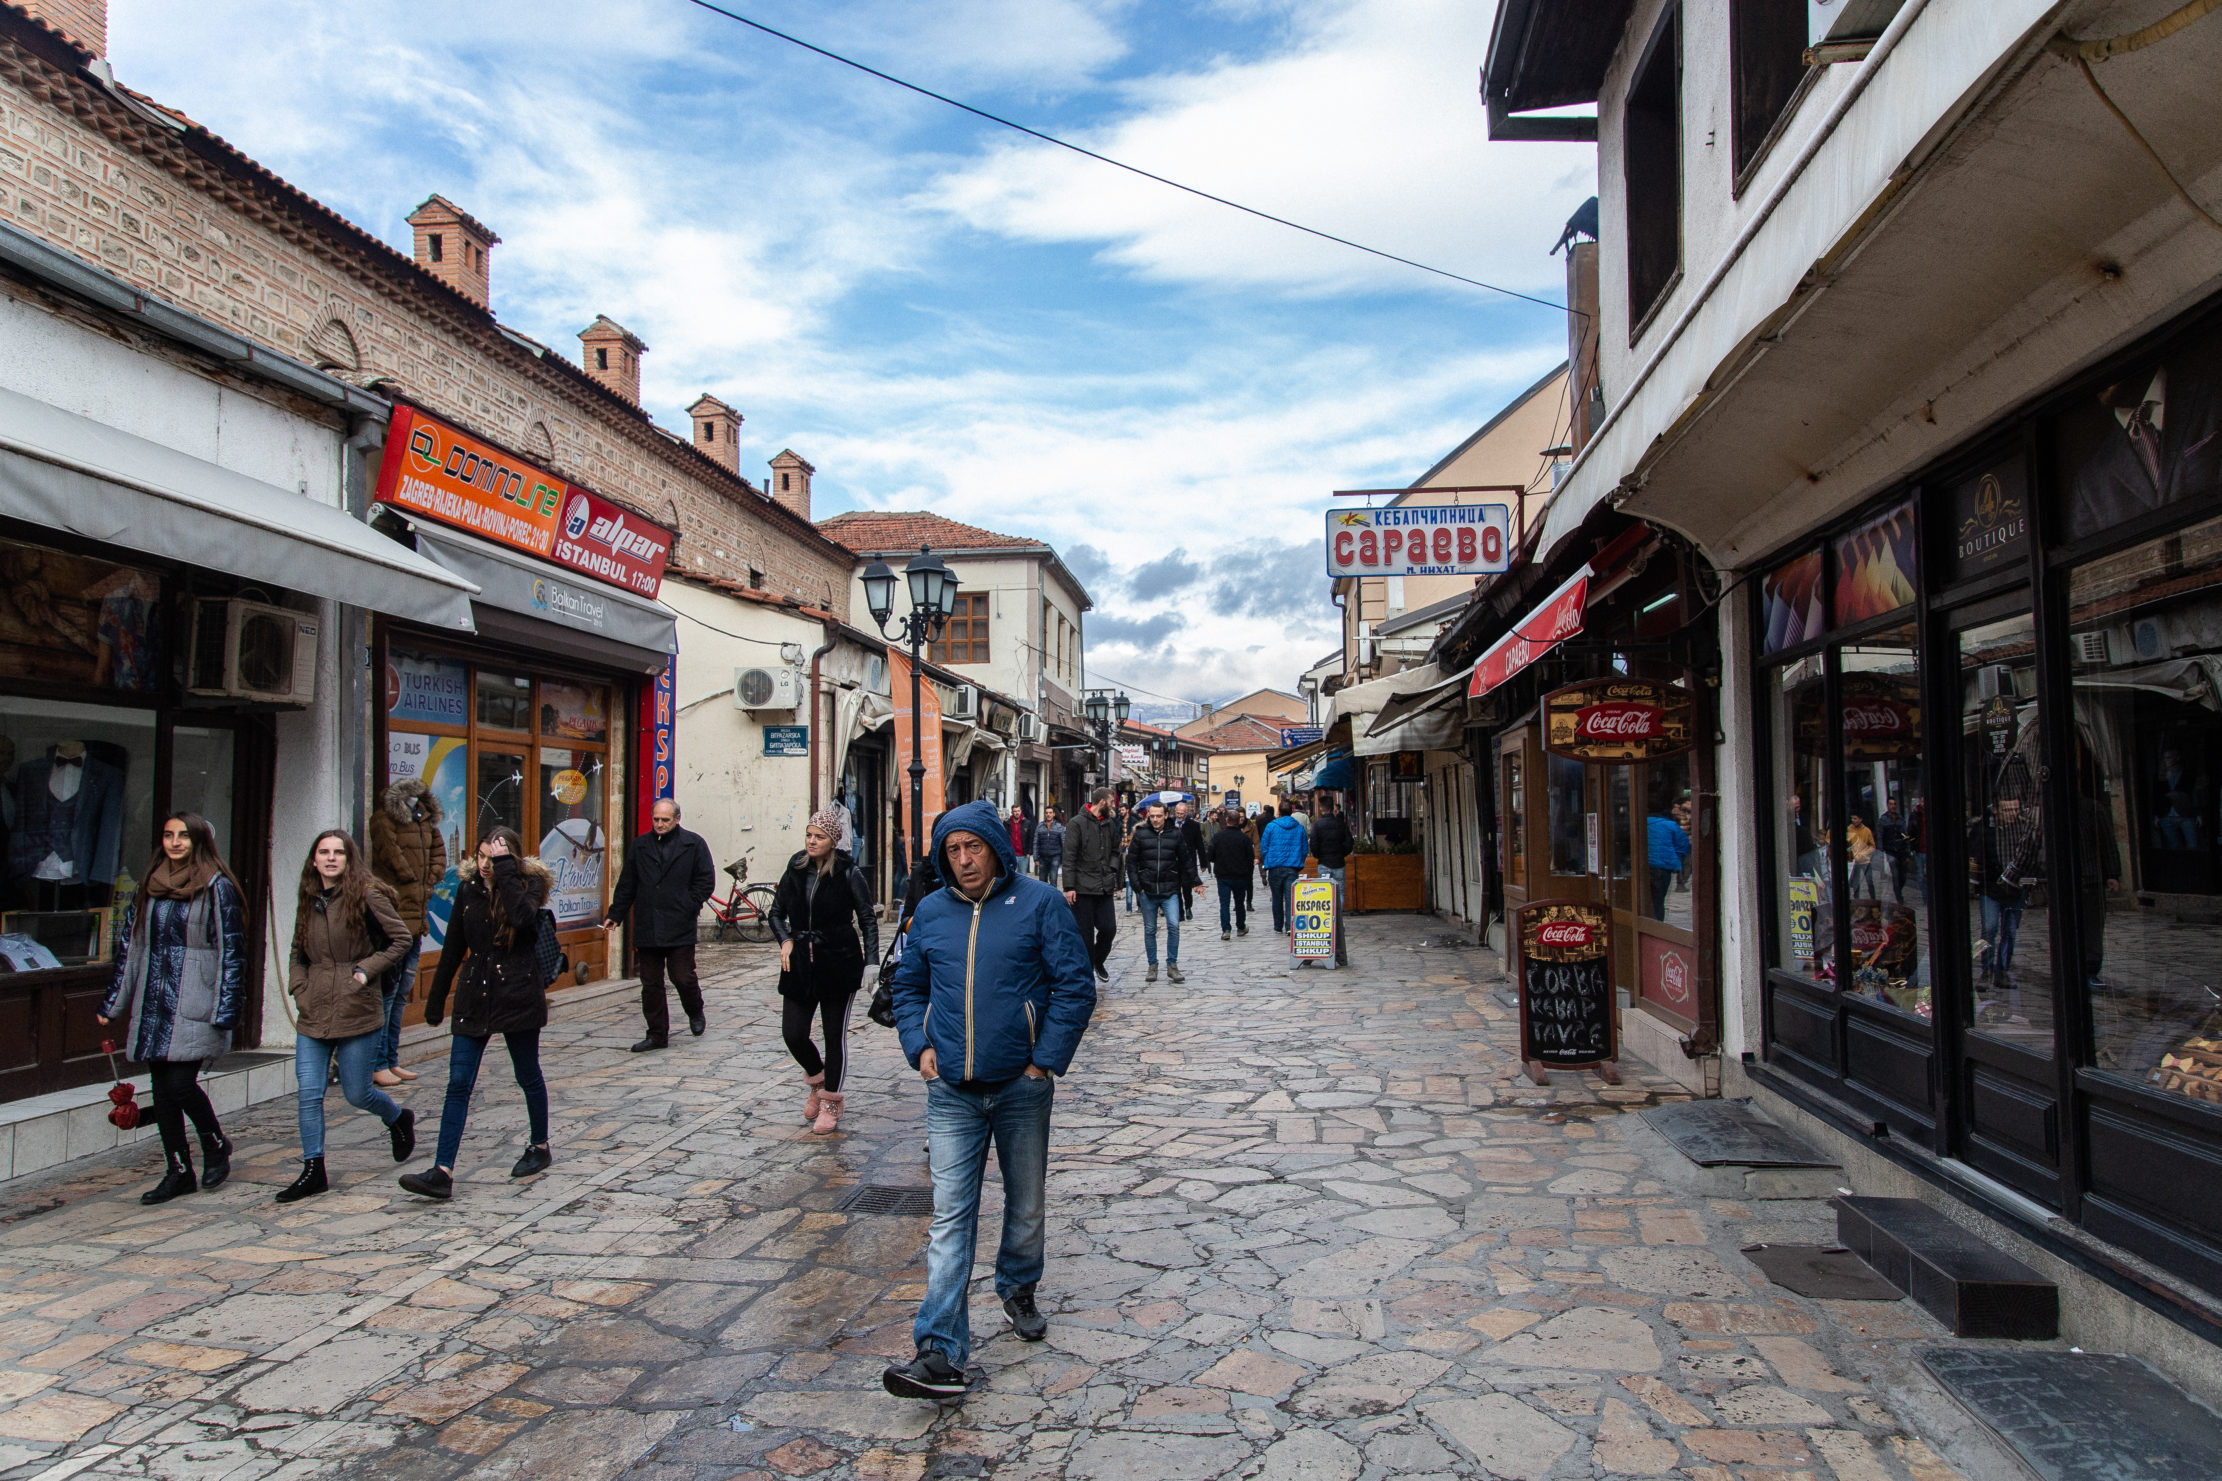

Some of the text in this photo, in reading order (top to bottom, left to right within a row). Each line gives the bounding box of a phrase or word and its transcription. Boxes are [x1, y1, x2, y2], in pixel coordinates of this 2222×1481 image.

[1375, 508, 1486, 526] КЕБАПЧИЛНИЦА
[588, 514, 665, 559] alpar
[1959, 518, 2024, 558] BOUTIQUE
[1419, 566, 1456, 574] НИХАТ
[631, 571, 656, 593] 17:00
[404, 671, 463, 695] TURKISH
[404, 692, 463, 715] AIRLINES
[1586, 711, 1652, 734] Coca-Cola
[400, 760, 415, 773] Bus
[1296, 900, 1331, 912] EKSPRES
[1543, 926, 1587, 942] Coca-Cola
